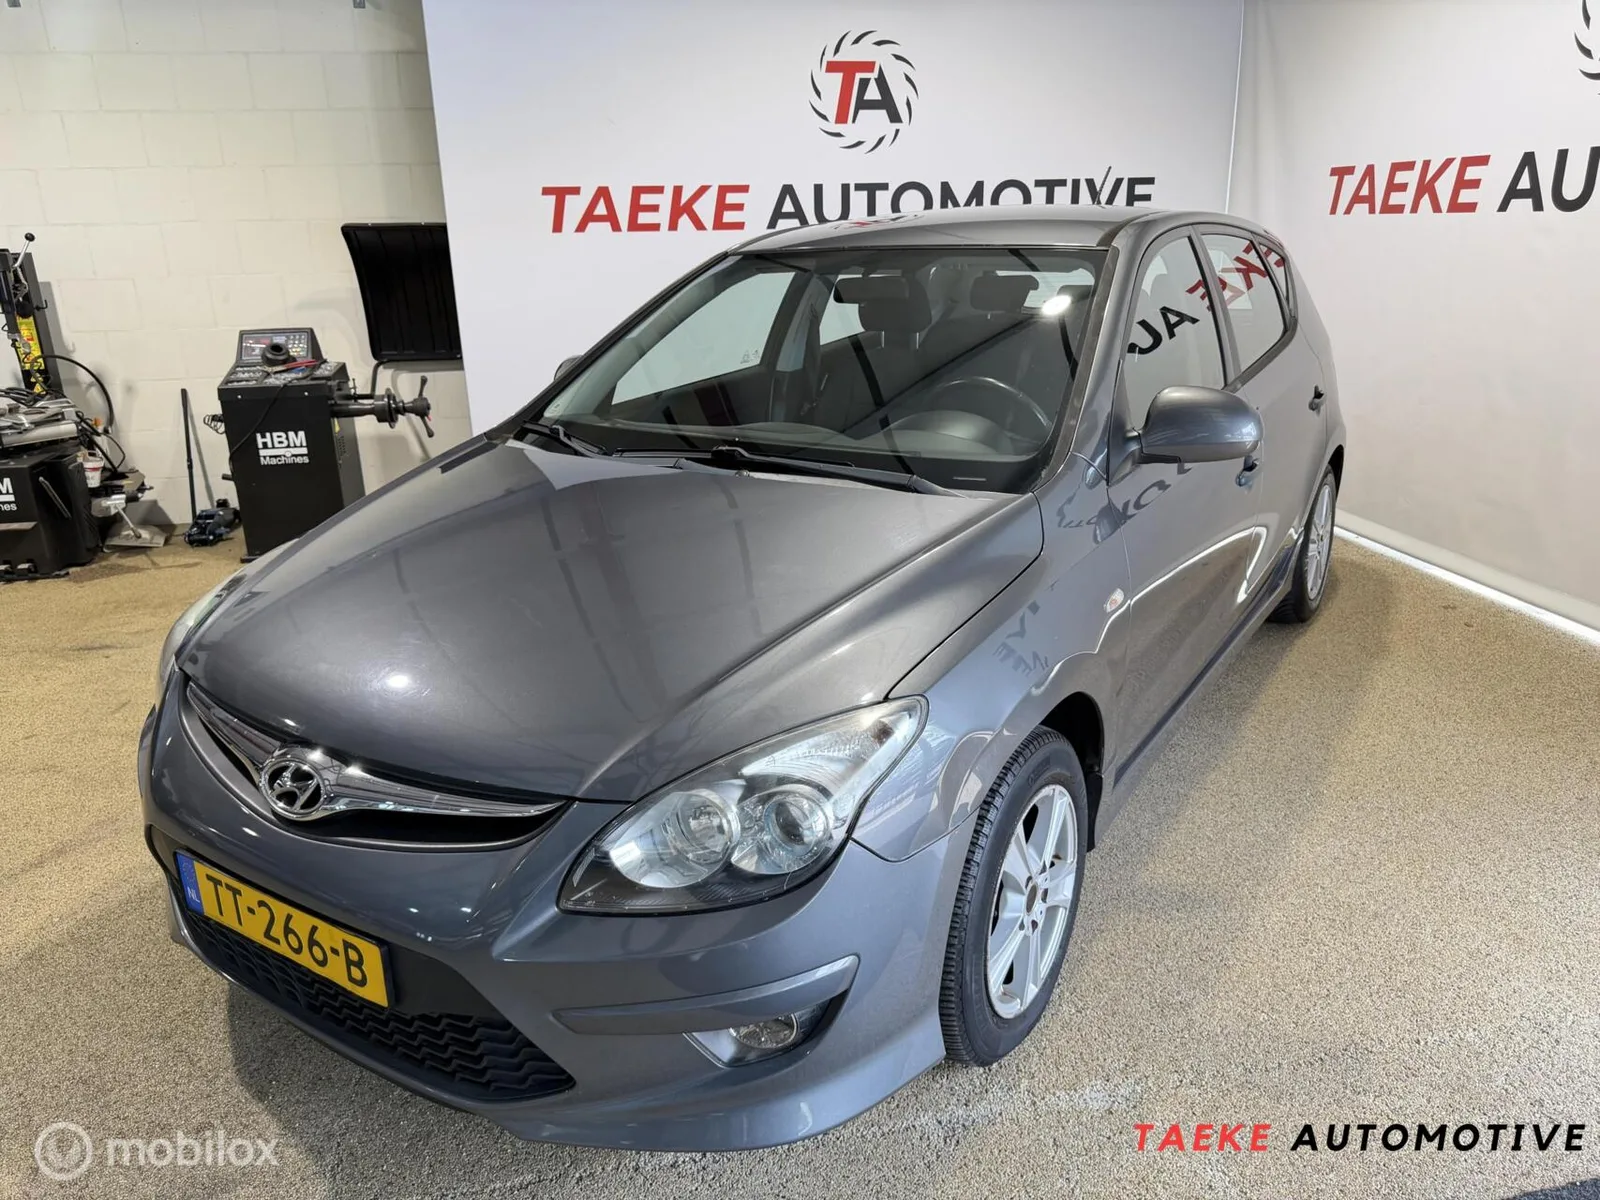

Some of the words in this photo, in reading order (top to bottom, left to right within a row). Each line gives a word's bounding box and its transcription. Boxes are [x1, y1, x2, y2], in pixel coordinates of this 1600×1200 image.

[824, 60, 904, 125] TA
[541, 184, 750, 234] TAEKE
[766, 176, 1156, 230] AUTOMOTIVE
[1328, 154, 1491, 215] TAEKE
[256, 430, 307, 449] HBM
[260, 455, 310, 466] Machines
[187, 886, 200, 903] NL
[205, 873, 368, 988] TT-266-B
